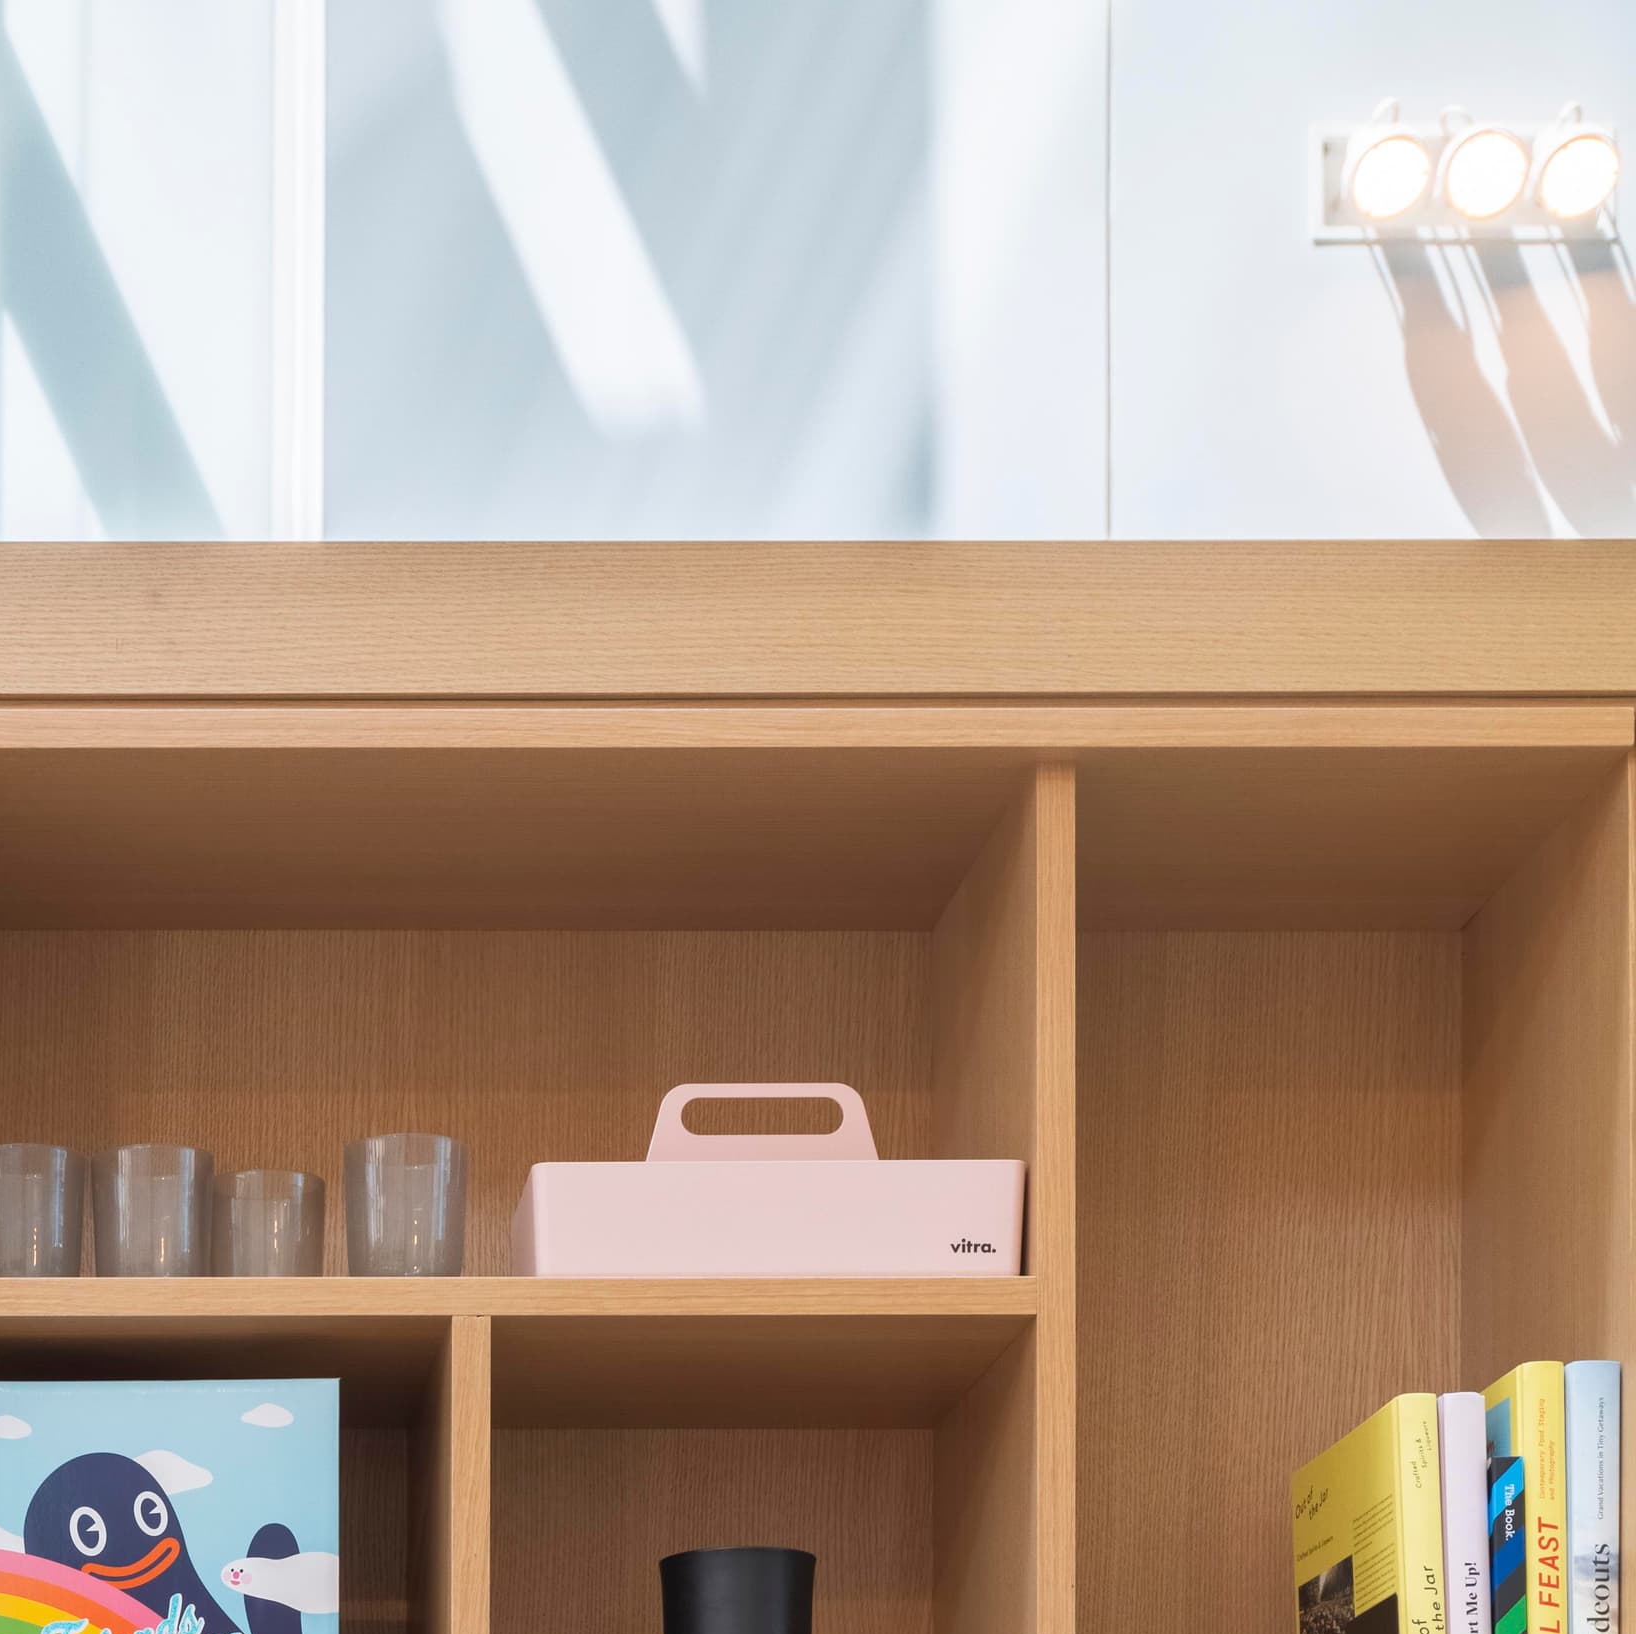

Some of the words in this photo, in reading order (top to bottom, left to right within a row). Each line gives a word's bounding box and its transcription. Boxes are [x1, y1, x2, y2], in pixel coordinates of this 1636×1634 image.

[950, 1238, 996, 1253] vitra.
[1505, 1484, 1514, 1505] The
[1505, 1509, 1515, 1541] Book.
[1464, 1562, 1479, 1587] Up!
[1538, 1517, 1559, 1608] FEAST
[1423, 1566, 1438, 1595] Jar
[1466, 1592, 1478, 1615] Me
[1412, 1619, 1429, 1634] of
[1429, 1602, 1444, 1631] the
